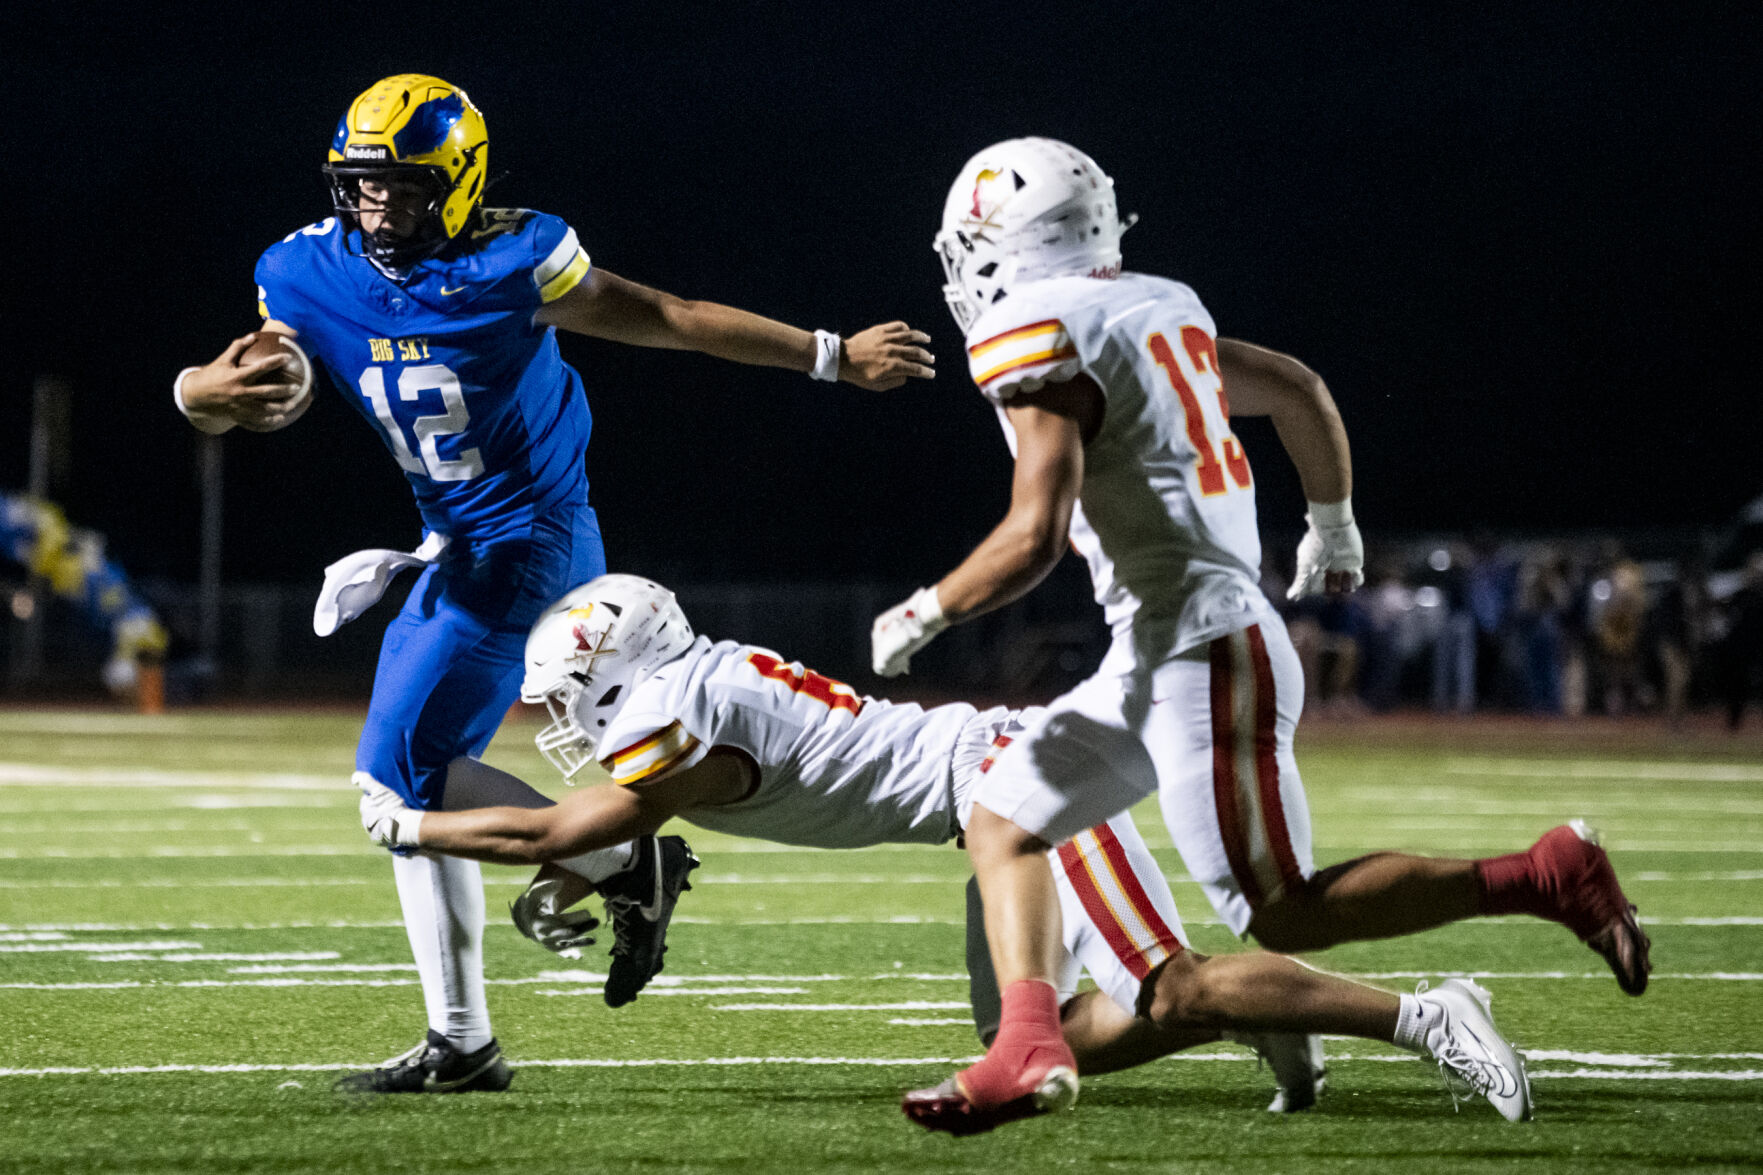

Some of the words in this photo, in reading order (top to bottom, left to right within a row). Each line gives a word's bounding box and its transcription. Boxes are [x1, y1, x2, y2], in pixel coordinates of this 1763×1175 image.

[346, 148, 386, 159] Riddell
[368, 338, 395, 362] BIG
[398, 338, 430, 361] SKY
[359, 364, 486, 482] 12
